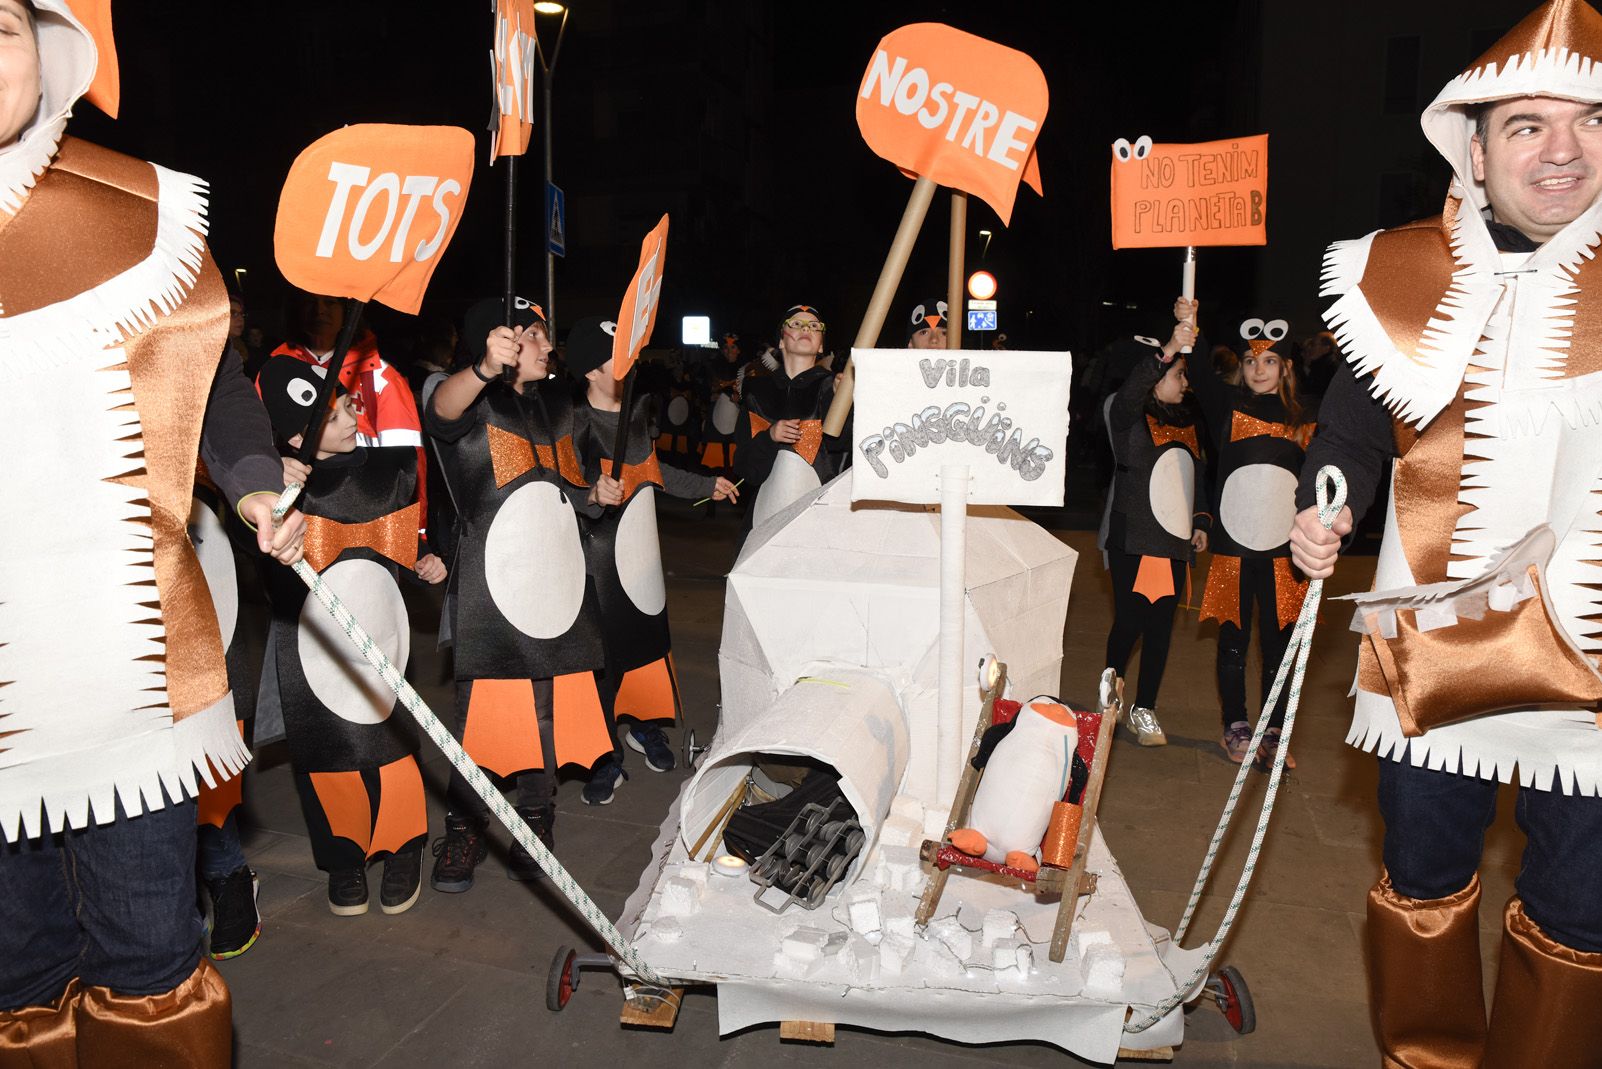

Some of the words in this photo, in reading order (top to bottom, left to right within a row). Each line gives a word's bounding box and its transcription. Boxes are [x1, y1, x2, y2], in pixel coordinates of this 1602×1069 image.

[861, 49, 1037, 171] NOSTRE
[1141, 156, 1175, 189] NO
[315, 161, 461, 263] TOTS
[1134, 191, 1247, 233] PLANETA
[1250, 190, 1263, 226] B
[919, 358, 990, 388] Vila
